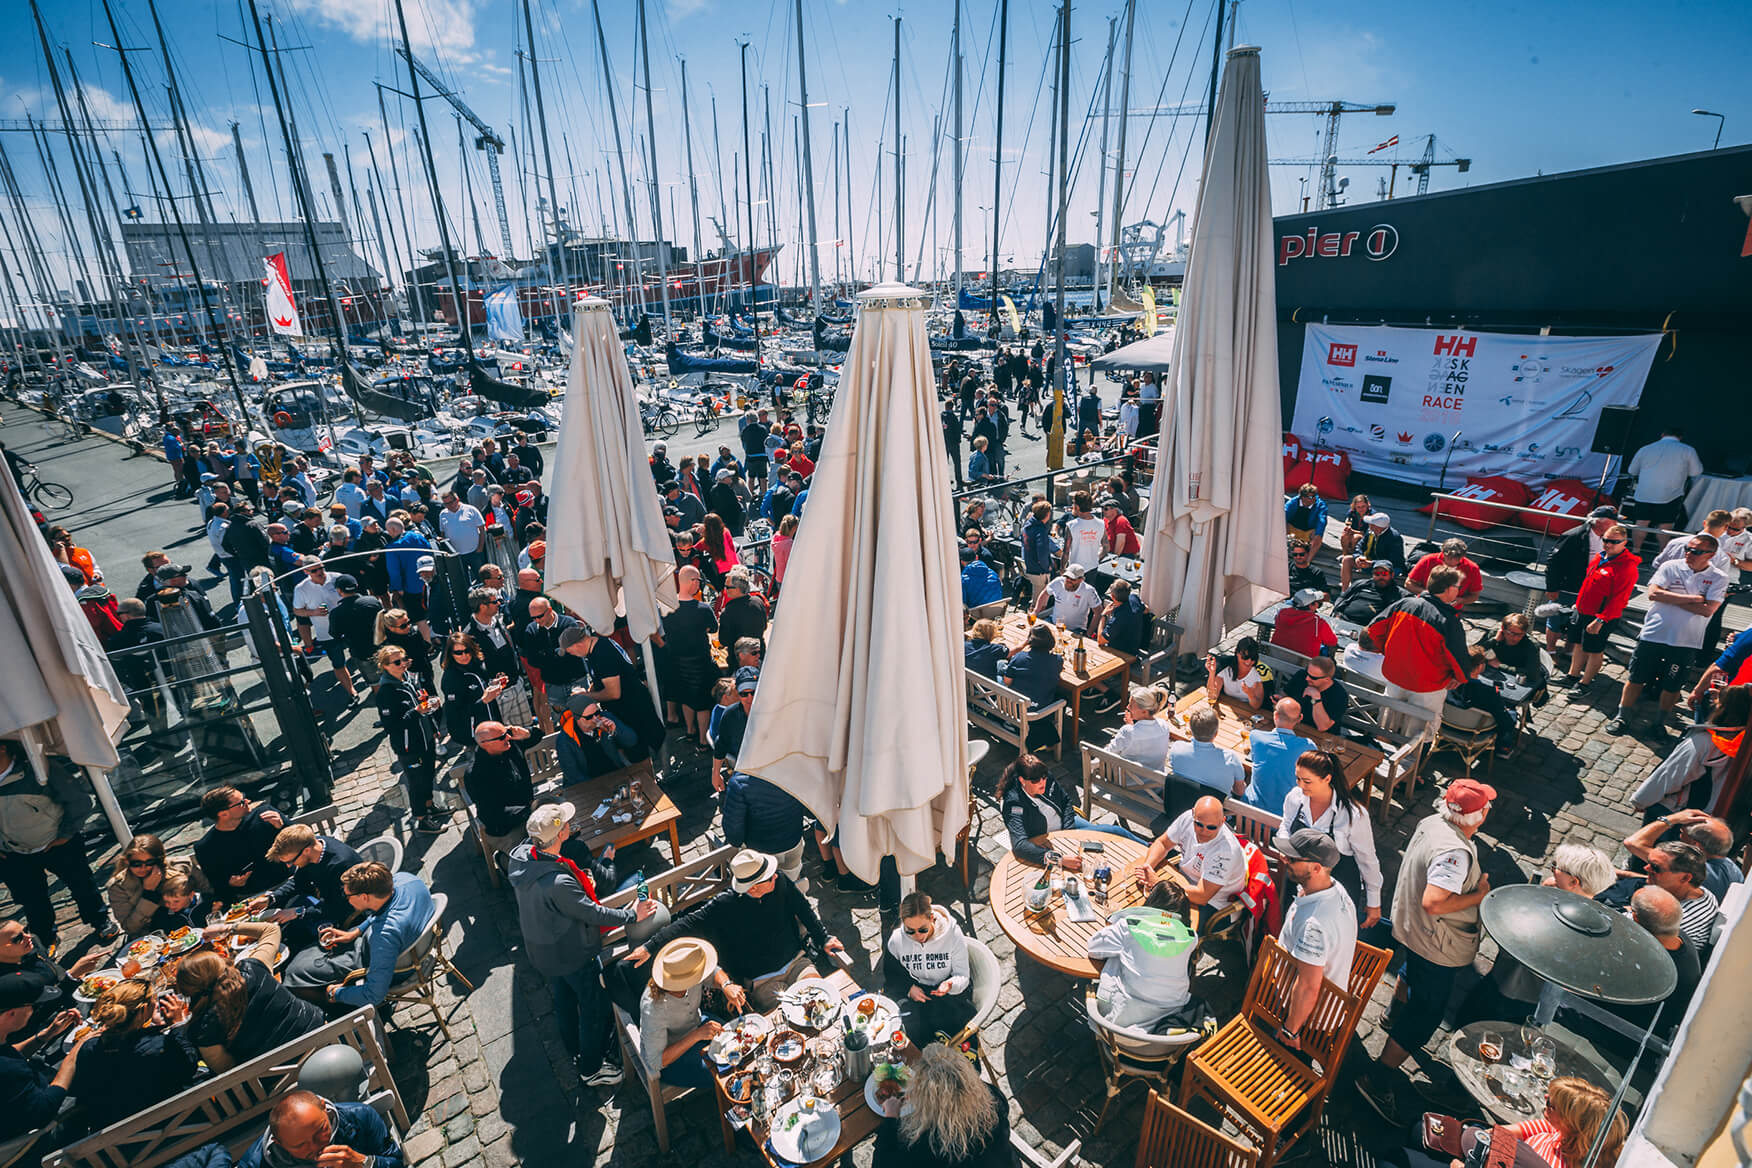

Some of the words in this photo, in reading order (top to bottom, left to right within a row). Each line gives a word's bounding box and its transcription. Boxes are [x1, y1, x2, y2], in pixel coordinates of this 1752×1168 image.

[1279, 226, 1360, 266] pier
[1332, 346, 1352, 360] HH
[1433, 335, 1477, 357] HH
[1451, 359, 1470, 370] SK
[1446, 371, 1469, 382] AG
[1444, 384, 1465, 395] EN
[1422, 395, 1464, 410] RACE
[1448, 484, 1497, 501] HH
[1530, 488, 1580, 514] HH
